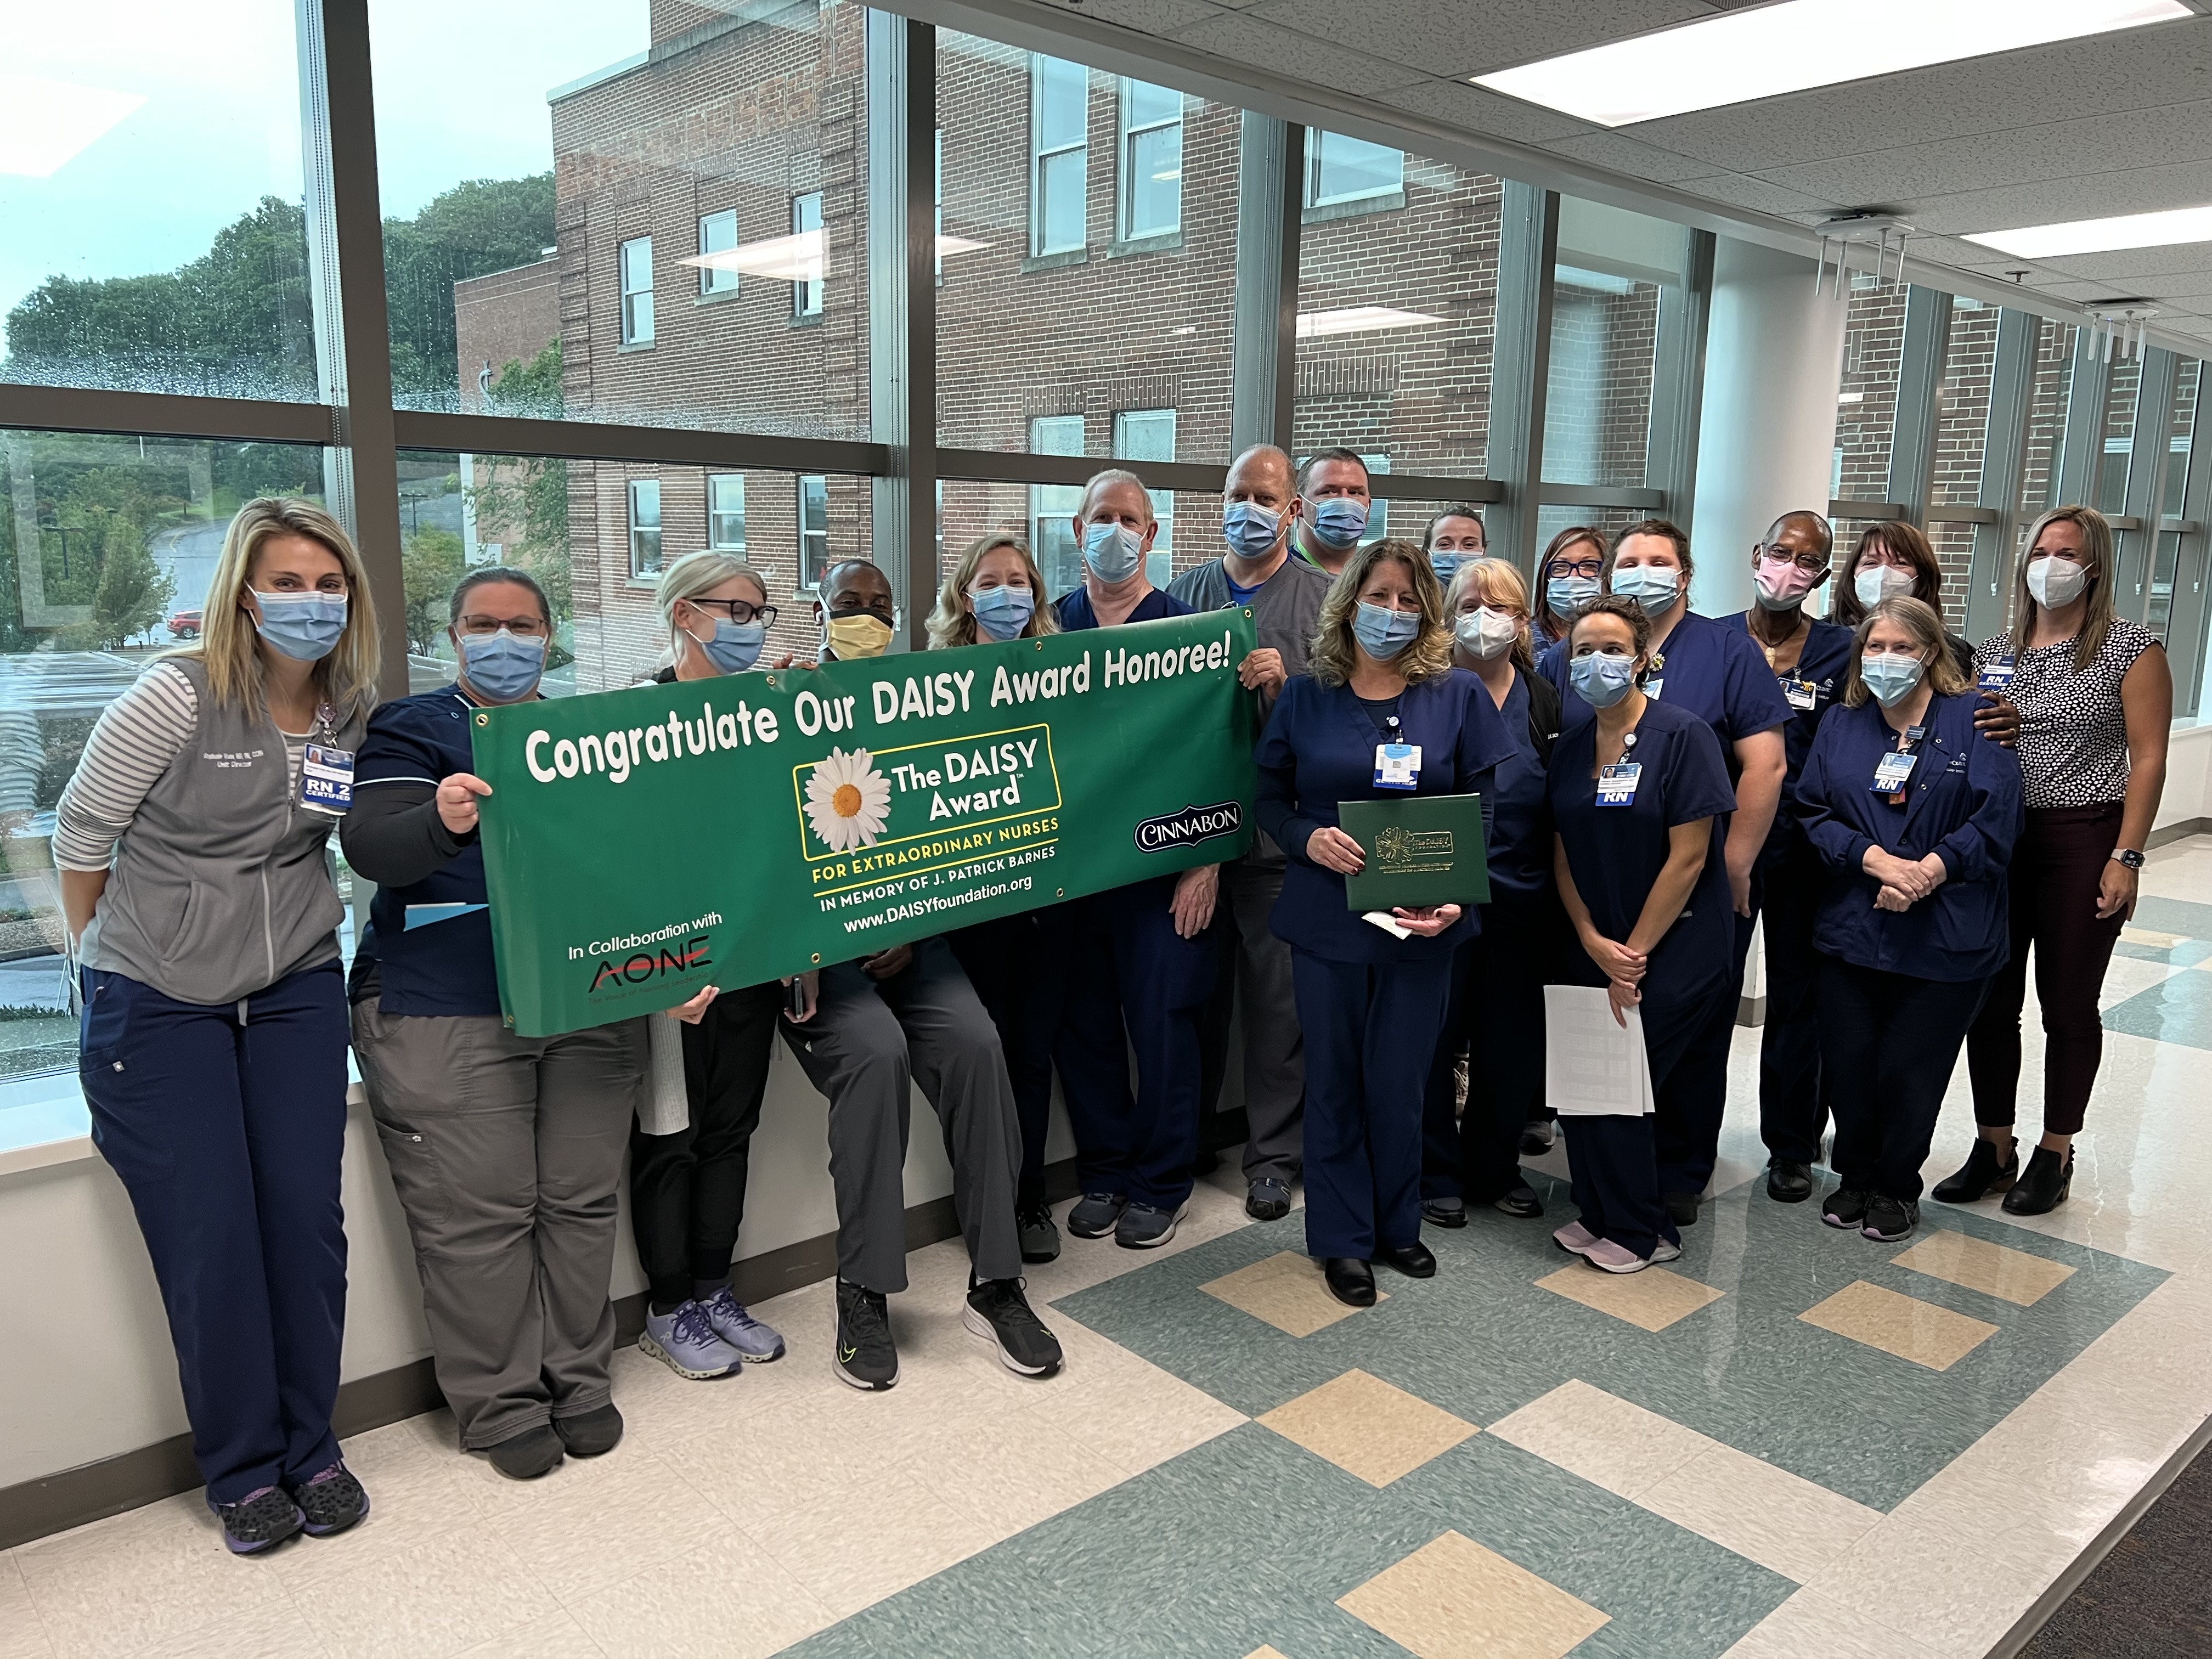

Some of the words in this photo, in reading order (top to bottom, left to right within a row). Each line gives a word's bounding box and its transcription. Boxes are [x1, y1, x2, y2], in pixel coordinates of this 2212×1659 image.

[526, 700, 779, 783] Congratulate
[794, 691, 855, 736] Our
[872, 669, 974, 724] DAISY
[990, 651, 1090, 708] Award
[1104, 630, 1231, 689] Honoree!
[307, 779, 333, 793] RN
[339, 785, 350, 796] 2
[891, 763, 941, 793] The
[944, 738, 1037, 784] DAISY
[1876, 779, 1899, 790] RN
[306, 789, 351, 801] CERTIFIED
[1604, 793, 1628, 802] RN
[812, 864, 847, 884] FOR
[853, 831, 993, 874] EXTRAORDINARY
[999, 817, 1059, 842] NURSES
[1142, 808, 1238, 846] CINNABON
[820, 897, 837, 912] IN
[840, 882, 905, 908] MEMORY
[909, 876, 929, 890] OF
[933, 873, 945, 885] J.
[949, 859, 1006, 882] PATRICK
[1008, 846, 1056, 868] BARNES
[844, 877, 1032, 933] www.DAISYfoundation.org
[568, 946, 584, 960] In
[589, 922, 690, 955] Collaboration
[692, 911, 723, 930] with
[588, 935, 713, 993] AONE
